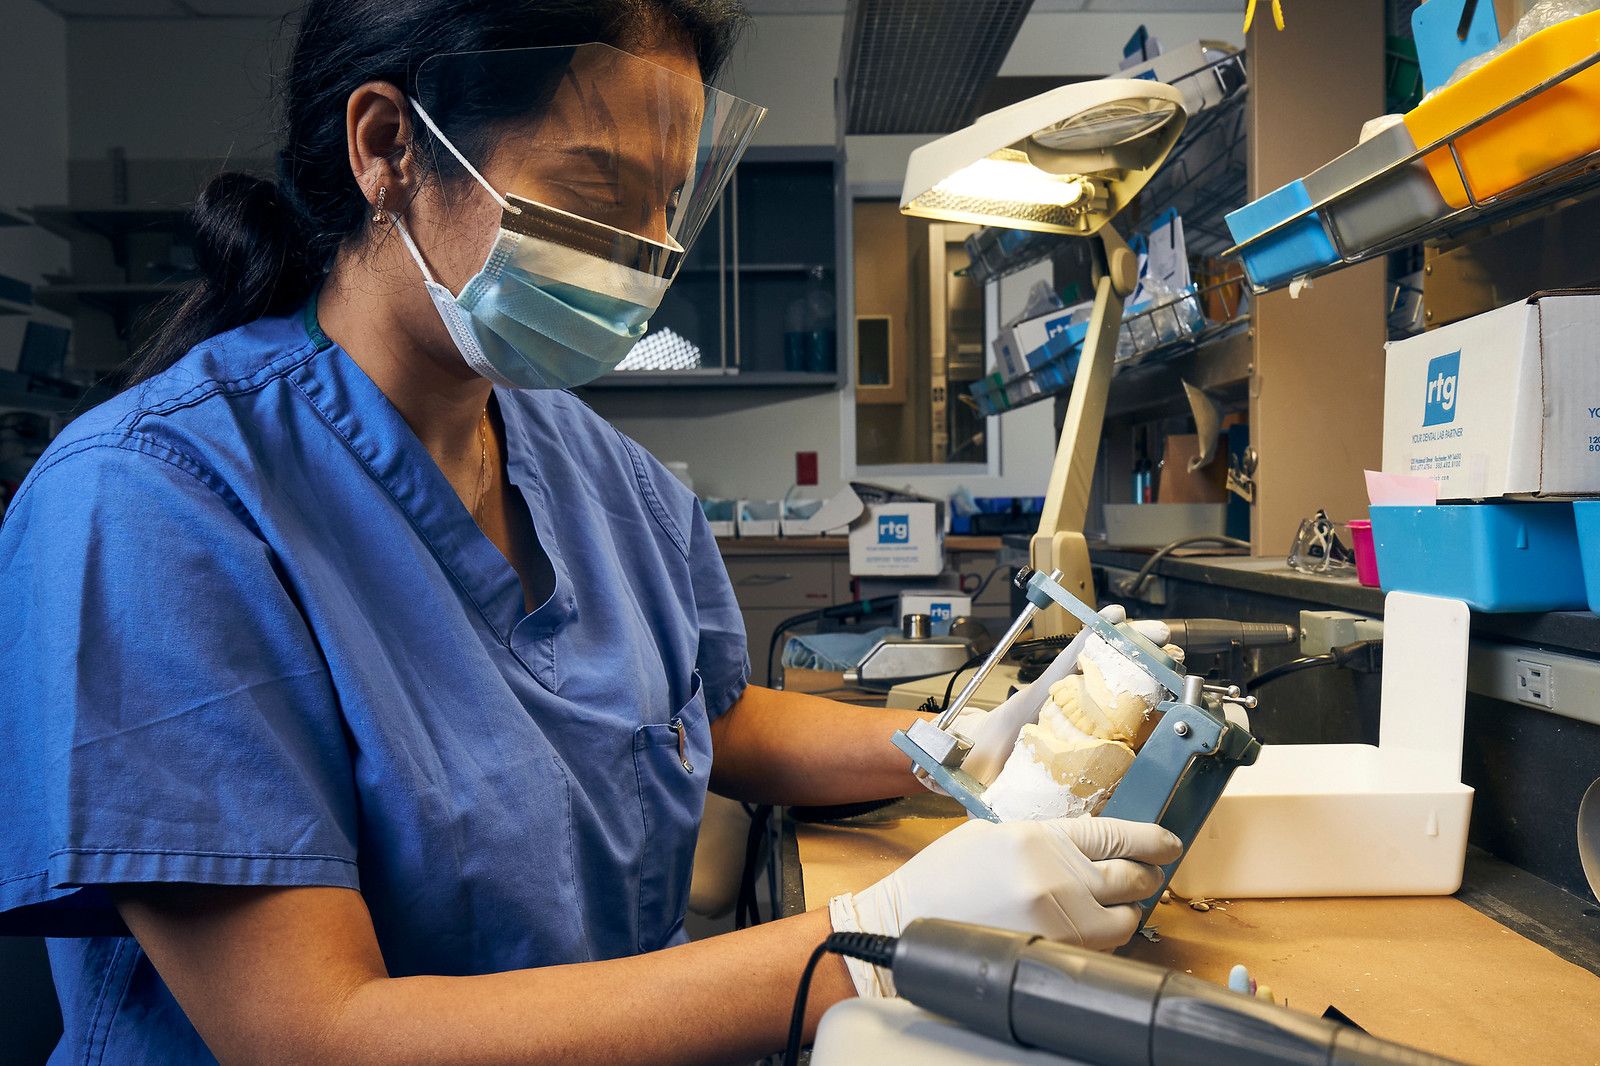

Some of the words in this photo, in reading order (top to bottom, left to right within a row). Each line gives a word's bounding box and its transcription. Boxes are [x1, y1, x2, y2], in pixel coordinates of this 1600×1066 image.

[1427, 372, 1456, 410] rtg
[880, 521, 908, 539] rtg
[931, 608, 951, 621] rtg
